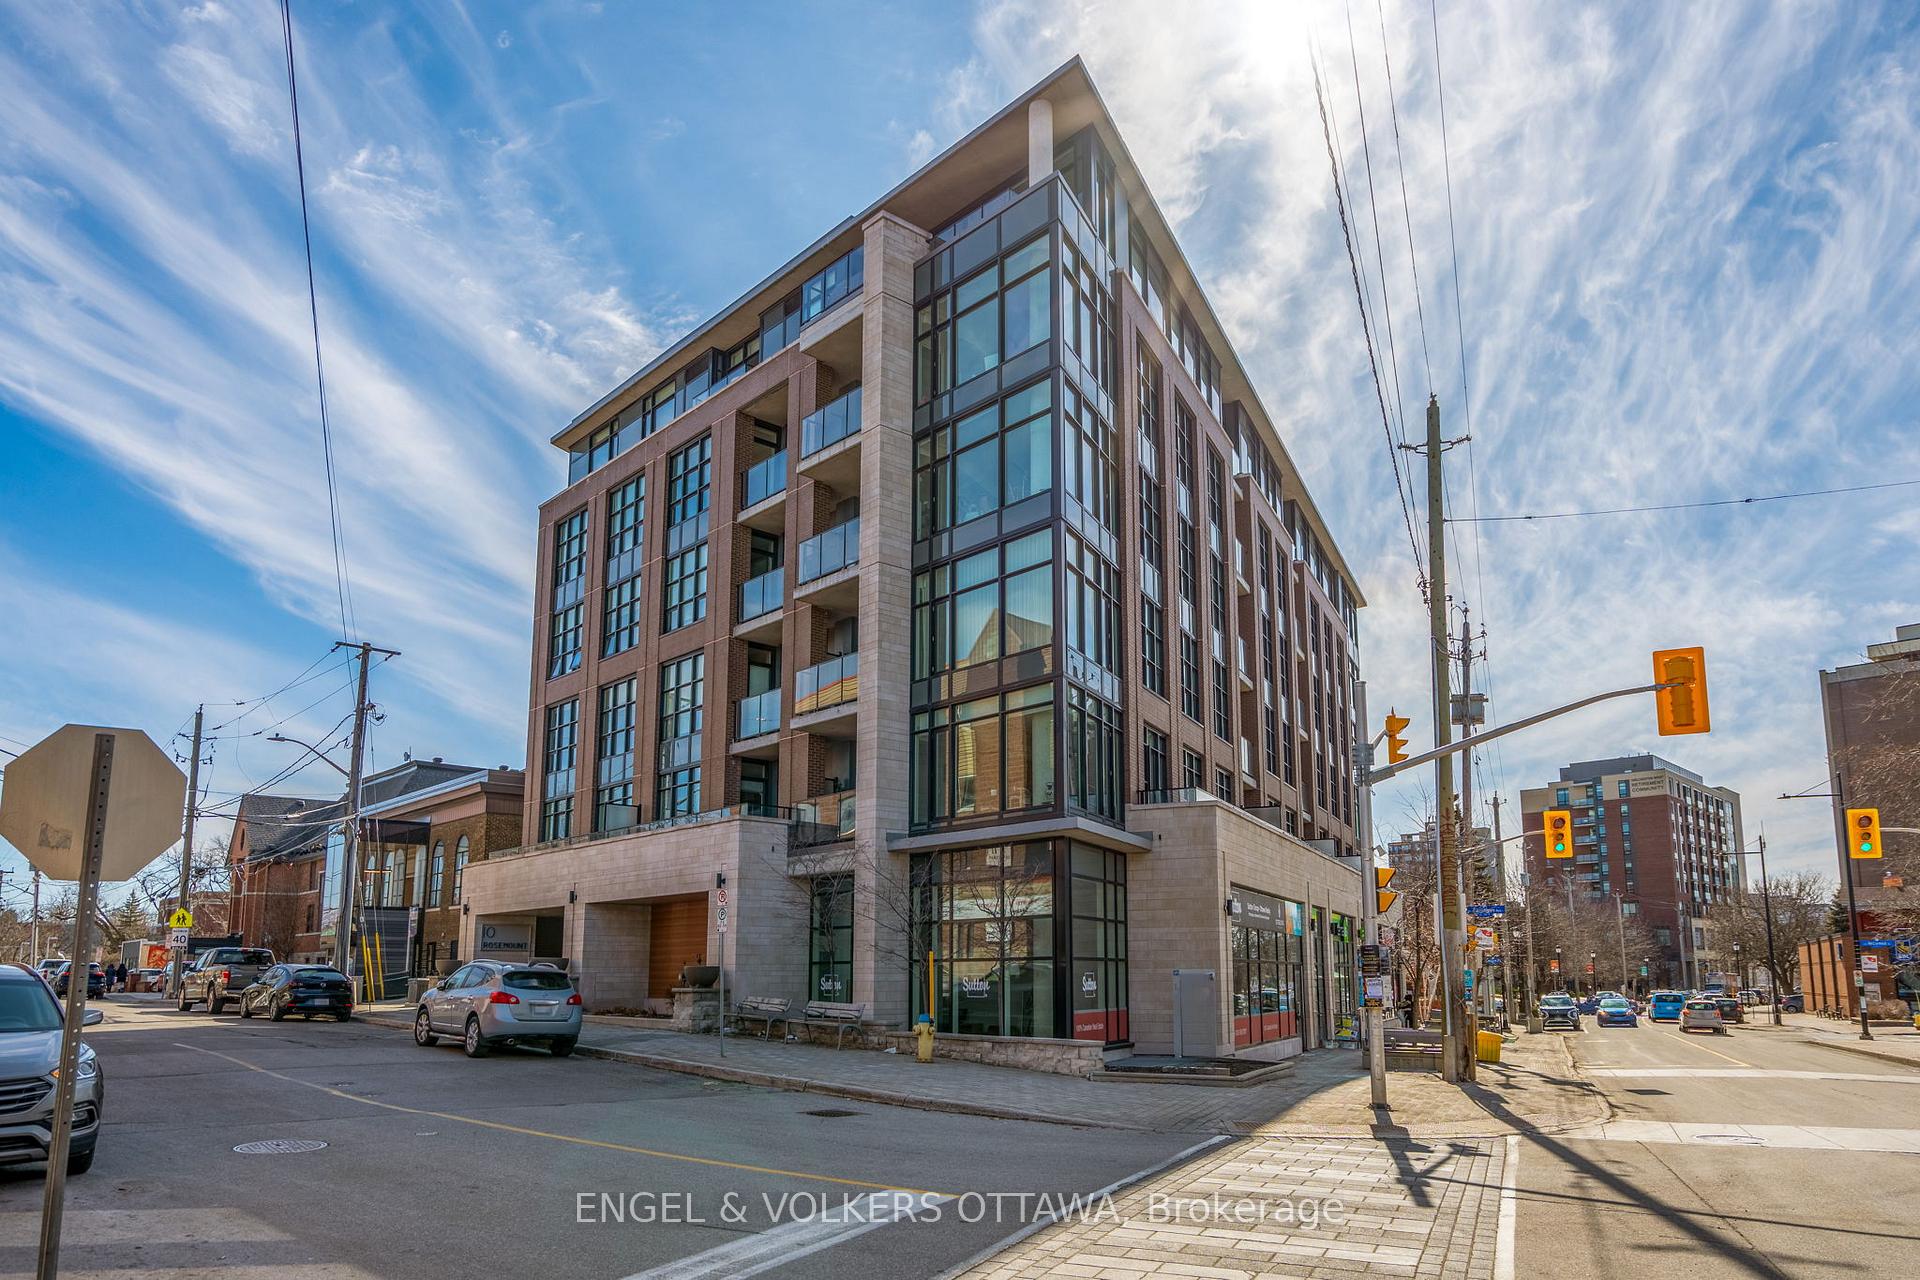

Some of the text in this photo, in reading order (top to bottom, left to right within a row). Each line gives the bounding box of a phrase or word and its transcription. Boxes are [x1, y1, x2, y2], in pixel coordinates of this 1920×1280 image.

[172, 935, 187, 944] 40
[482, 941, 528, 949] ROSEMOUNT
[962, 976, 991, 991] Sutton
